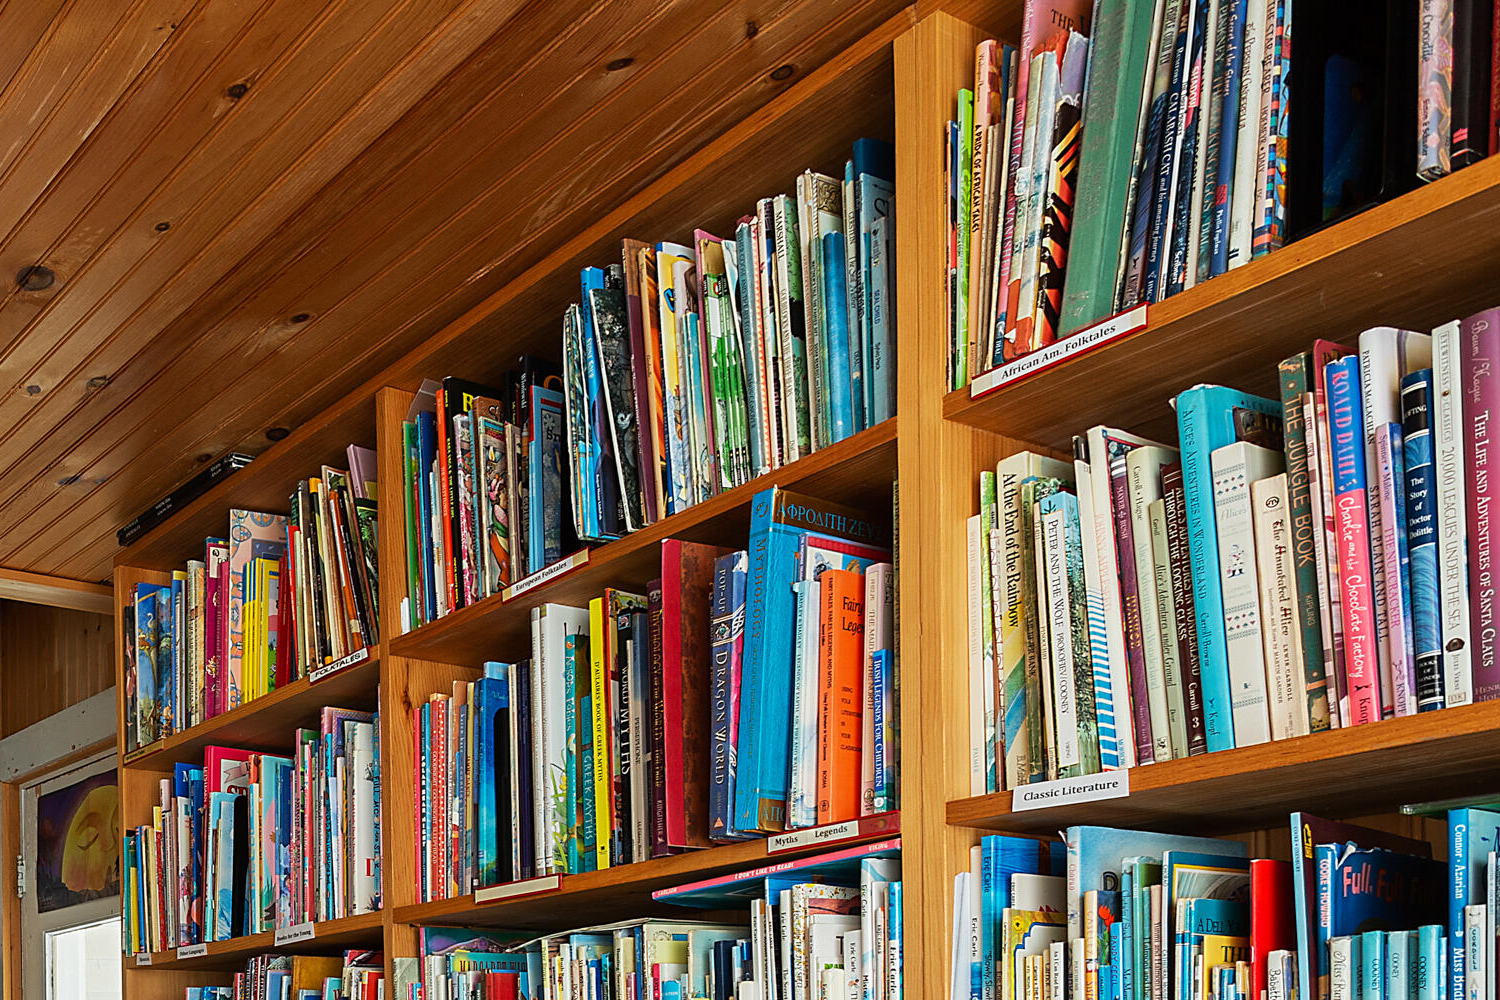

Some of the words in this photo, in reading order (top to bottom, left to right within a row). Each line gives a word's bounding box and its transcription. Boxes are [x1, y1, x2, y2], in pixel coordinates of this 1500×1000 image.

[1001, 357, 1039, 380] African
[1041, 347, 1062, 363] Am.
[1064, 325, 1116, 352] Folktales
[1284, 393, 1302, 432] THE
[1332, 370, 1354, 429] ROALD
[1288, 440, 1311, 509] JUNGLE
[1335, 433, 1357, 479] DAHL
[1440, 449, 1459, 486] 20,000
[1410, 489, 1428, 500] Story
[1411, 477, 1424, 487] The
[1338, 497, 1365, 541] Charlie
[1410, 513, 1432, 526] Doctor
[1414, 501, 1423, 511] of
[1443, 488, 1458, 538] LEAGUES
[1292, 513, 1315, 568] BOOK
[1347, 542, 1358, 556] and
[1410, 526, 1433, 540] Dolittle
[515, 573, 541, 591] European
[541, 561, 568, 579] Folktales
[1446, 540, 1459, 580] UNDER
[718, 568, 727, 613] POP-UP
[1341, 575, 1368, 633] Chocolate
[1447, 582, 1460, 608] THE
[1448, 611, 1461, 631] SEA
[315, 653, 361, 677] FOLKTALES
[1346, 634, 1371, 679] Factory
[715, 651, 728, 722] DRAGON
[715, 726, 727, 785] WORLD
[1023, 789, 1060, 802] Classic
[1062, 780, 1119, 797] Literature
[775, 835, 799, 847] Myths
[815, 825, 848, 839] Legends
[755, 868, 768, 876] LIKE
[777, 862, 794, 871] READ!
[1453, 947, 1465, 972] Miss
